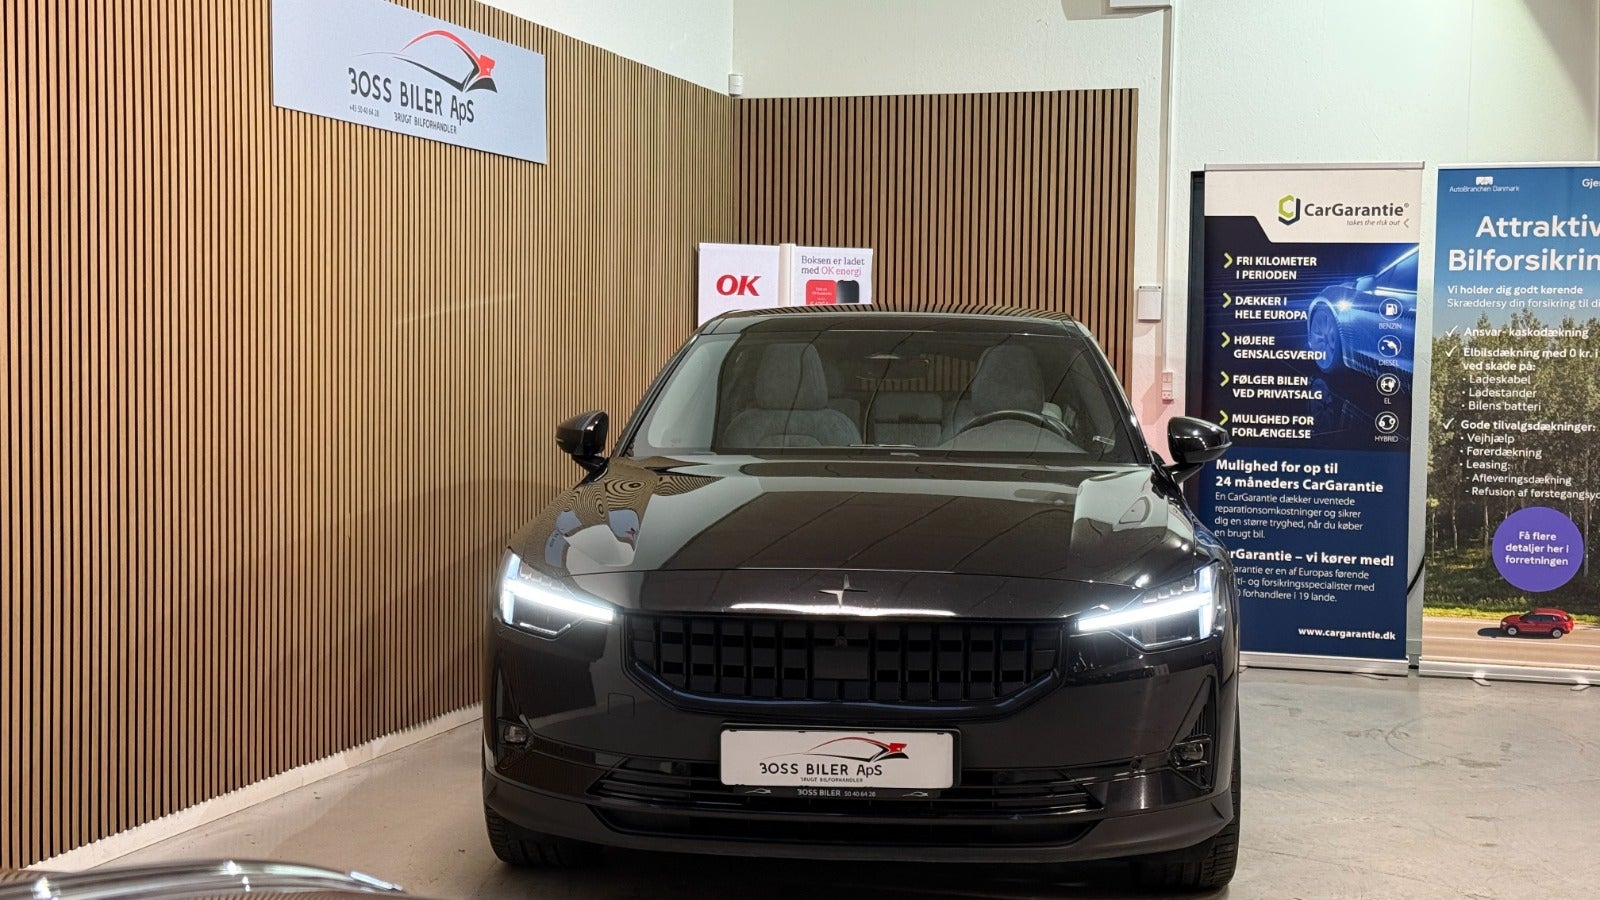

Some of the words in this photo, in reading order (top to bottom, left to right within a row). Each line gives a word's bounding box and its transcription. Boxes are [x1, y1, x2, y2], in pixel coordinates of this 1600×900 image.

[400, 81, 443, 116] BILER
[450, 95, 475, 126] ApS
[414, 117, 457, 134] BILFORHANDLER
[801, 256, 831, 265] Boksen
[844, 256, 865, 266] ladet
[1236, 256, 1253, 266] FRI
[1256, 257, 1317, 266] KILOMETER
[801, 266, 819, 275] med
[821, 267, 834, 275] OK
[836, 268, 862, 277] energi
[1236, 270, 1240, 279] I
[1242, 270, 1297, 280] PERIODEN
[716, 274, 762, 296] OK
[1448, 285, 1458, 294] Vi
[1460, 285, 1493, 294] holder
[1496, 285, 1511, 296] dig
[1514, 286, 1538, 296] godt
[1541, 286, 1583, 294] kørende
[1235, 296, 1282, 306] DÆKKER
[1284, 297, 1287, 306] I
[1448, 299, 1506, 309] Skræddersy
[1509, 299, 1525, 308] din
[1528, 298, 1575, 309] forsikring
[1578, 299, 1588, 308] til
[1235, 310, 1261, 320] HELE
[1264, 310, 1307, 320] EUROPA
[1464, 328, 1506, 337] Ansvar-
[1509, 328, 1589, 340] kaskodækning
[1234, 335, 1275, 346] HØJERE
[1234, 350, 1326, 360] GENSALGSVÆRDI
[1464, 348, 1539, 359] Elbilsdækning
[1542, 348, 1566, 358] med
[1570, 349, 1576, 358] 0
[1579, 348, 1592, 358] kr.
[1462, 362, 1482, 370] ved
[1485, 362, 1516, 371] skade
[1519, 362, 1536, 373] på:
[1233, 376, 1274, 385] FØLGER
[1277, 376, 1308, 386] BILEN
[1470, 375, 1531, 385] Ladeskabel
[1232, 389, 1254, 398] VED
[1257, 389, 1322, 400] PRIVATSALG
[1469, 388, 1536, 398] Ladestander
[1469, 401, 1502, 410] Bilens
[1504, 402, 1541, 411] batteri
[1232, 414, 1289, 425] MULIGHED
[1292, 416, 1314, 425] FOR
[1461, 420, 1490, 430] Gode
[1493, 420, 1596, 433] tilvalgsdækninger:
[1232, 428, 1311, 439] FORLÆNGELSE
[1467, 434, 1515, 444] Vejhjælp
[1467, 447, 1542, 459] Førerdækning
[1216, 460, 1277, 474] Mulighed
[1281, 460, 1301, 473] for
[1304, 464, 1321, 475] op
[1324, 462, 1338, 474] til
[1467, 460, 1510, 472] Leasing:
[1215, 476, 1232, 487] 24
[1235, 476, 1299, 490] måneders
[1303, 480, 1384, 493] CarGarantie
[1472, 474, 1572, 486] Afleveringsdækning
[1472, 487, 1515, 497] Refusion
[1518, 488, 1528, 497] af
[1215, 492, 1226, 501] En
[1228, 493, 1277, 503] CarGarantie
[1280, 494, 1311, 504] dækker
[1314, 496, 1355, 506] uventede
[1215, 505, 1322, 518] reparationsomkostninger
[1324, 510, 1336, 519] og
[1338, 509, 1361, 518] sikrer
[1215, 517, 1228, 528] dig
[1243, 518, 1267, 528] større
[1270, 520, 1306, 530] tryghed,
[1308, 520, 1322, 529] når
[1324, 520, 1335, 530] du
[1338, 521, 1363, 531] køber
[1227, 528, 1251, 540] brugt
[1253, 530, 1265, 539] bil.
[1519, 531, 1530, 540] Få
[1533, 532, 1557, 541] flere
[1505, 543, 1544, 554] detaljer
[1547, 545, 1564, 553] her
[1566, 545, 1569, 553] i
[1228, 549, 1292, 562] rGarantie
[1306, 552, 1318, 563] vi
[1321, 552, 1357, 565] kører
[1360, 555, 1394, 566] med!
[1505, 555, 1568, 567] forretningen
[1234, 566, 1263, 574] arantie
[1288, 567, 1297, 576] af
[1298, 568, 1333, 579] Europas
[1335, 569, 1369, 580] førende
[1248, 579, 1259, 587] og
[1262, 578, 1353, 591] forsikringsspecialister
[1355, 583, 1374, 592] med
[1243, 589, 1292, 599] forhandlere
[1299, 592, 1309, 600] 19
[1311, 593, 1337, 602] lande.
[1298, 628, 1396, 640] www.cargarantie.dk
[806, 764, 848, 775] BILER
[856, 764, 882, 778] ApS
[820, 789, 840, 797] BILER
